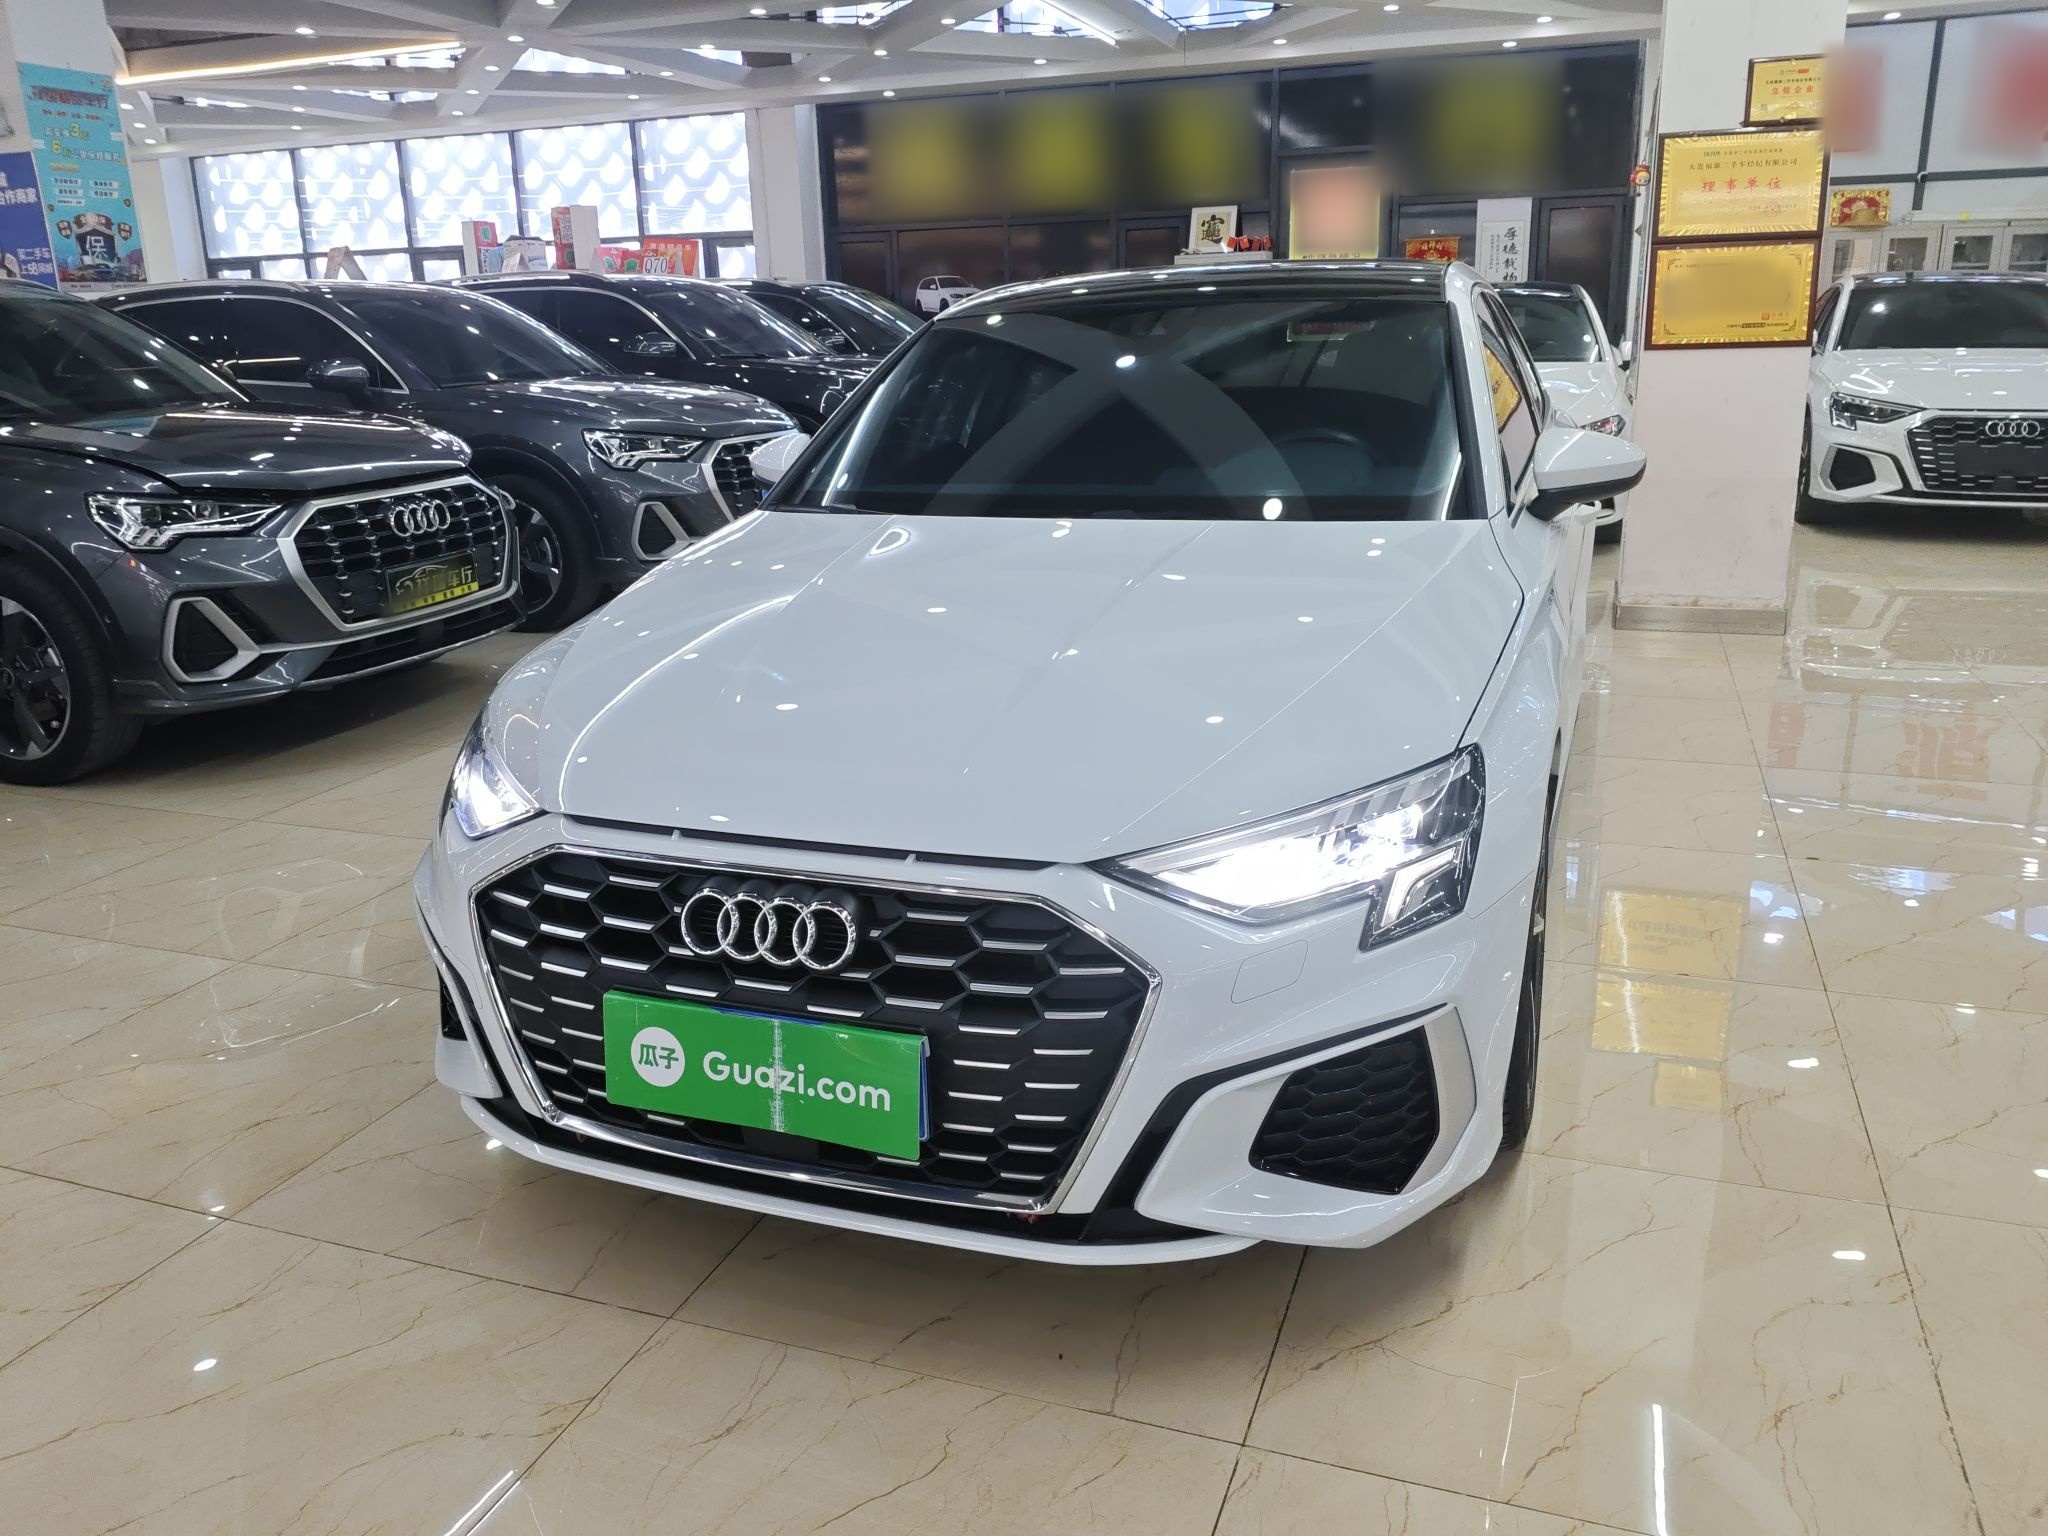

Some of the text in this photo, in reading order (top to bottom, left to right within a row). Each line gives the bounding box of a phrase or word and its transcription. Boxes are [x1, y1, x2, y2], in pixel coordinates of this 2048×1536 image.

[1701, 176, 1782, 193] 理事单位
[17, 247, 51, 260] 买二手车
[86, 235, 108, 261] 保
[637, 1043, 679, 1070] 瓜子
[702, 1050, 891, 1112] Guazi.com
